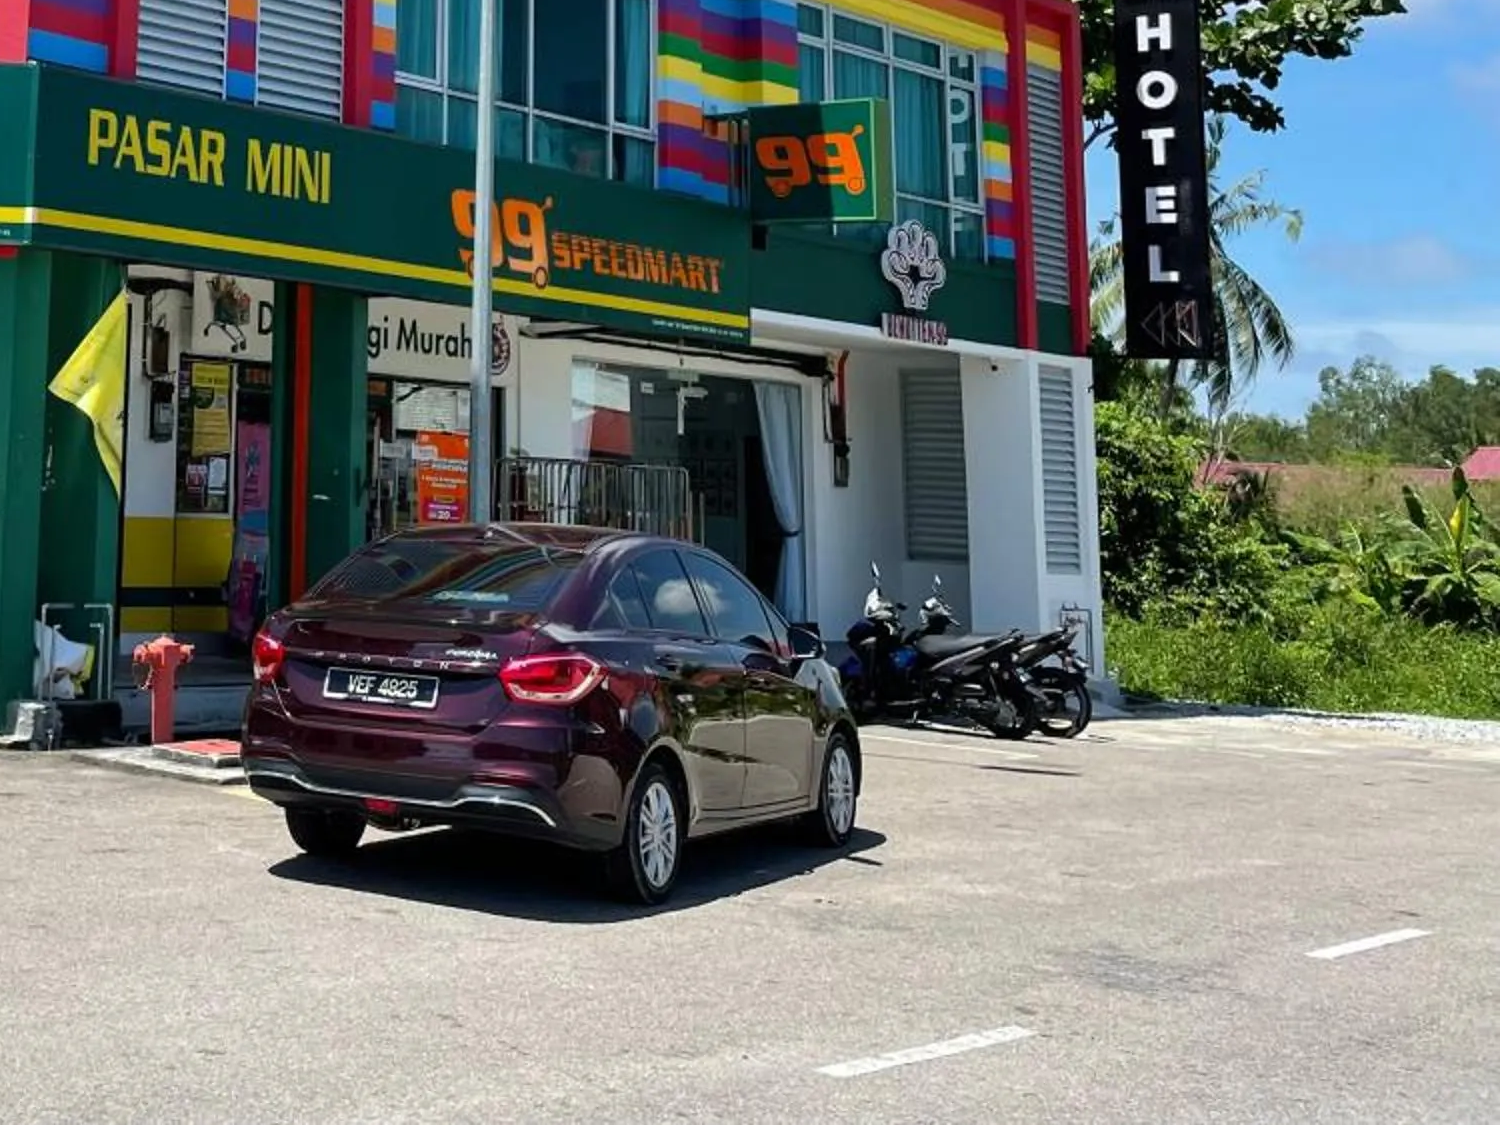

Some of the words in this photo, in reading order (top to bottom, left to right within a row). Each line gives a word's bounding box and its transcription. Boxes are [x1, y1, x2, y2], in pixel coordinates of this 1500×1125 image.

[87, 108, 226, 186] PASAR
[246, 139, 332, 204] MINI
[756, 125, 865, 198] 99
[1135, 12, 1180, 283] HOTEL
[451, 188, 553, 290] 99
[551, 231, 724, 294] SPEEDMART
[367, 316, 389, 357] gi
[396, 318, 472, 359] Murah
[313, 650, 449, 670] PROTON
[348, 674, 377, 694] VEF
[378, 677, 419, 698] 4825
